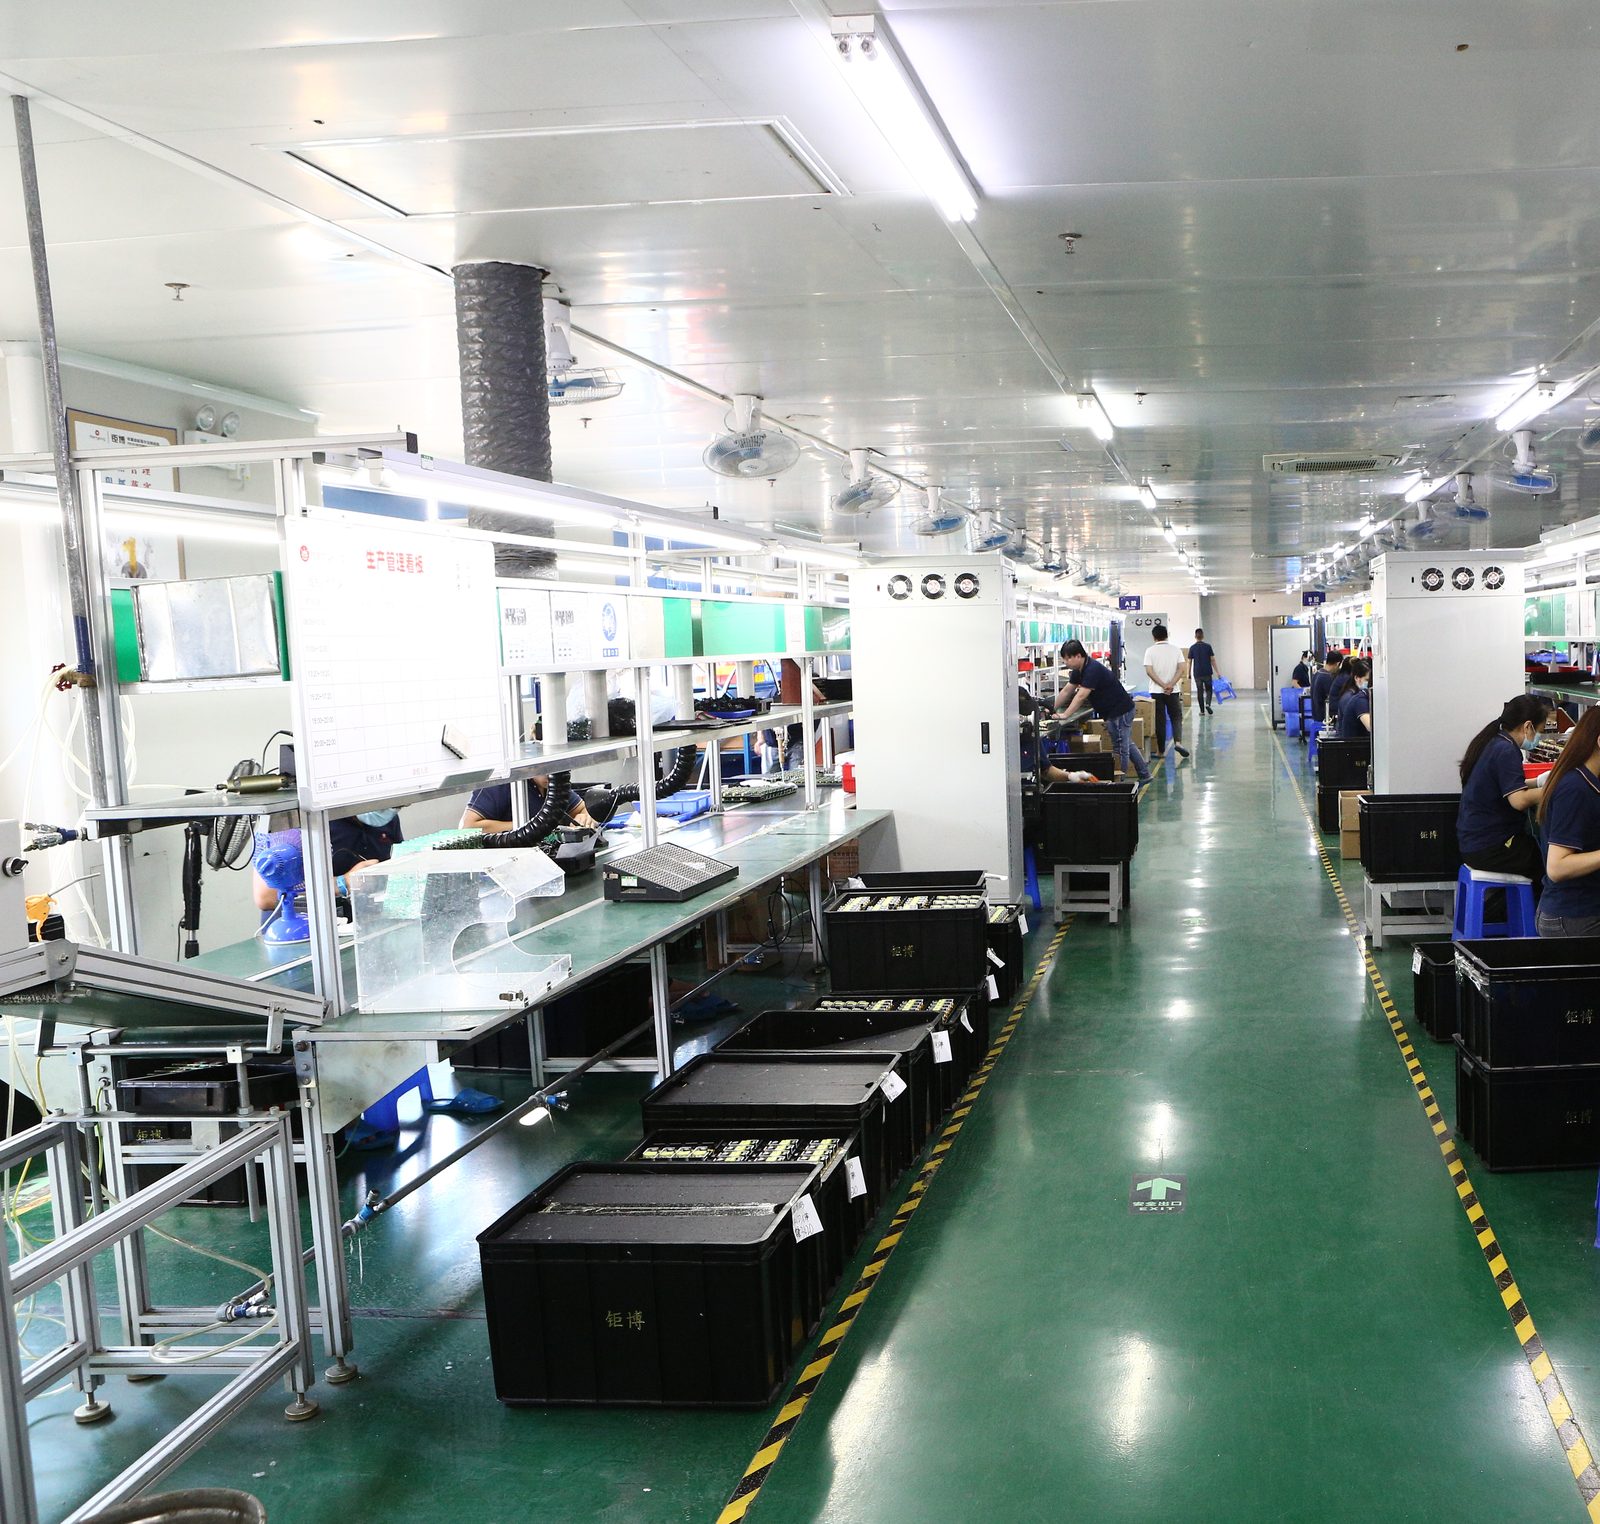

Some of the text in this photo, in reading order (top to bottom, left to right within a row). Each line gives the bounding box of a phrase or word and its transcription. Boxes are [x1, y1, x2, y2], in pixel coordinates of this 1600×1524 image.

[366, 550, 424, 574] 生产管理看板
[605, 1310, 646, 1331] 钜博
